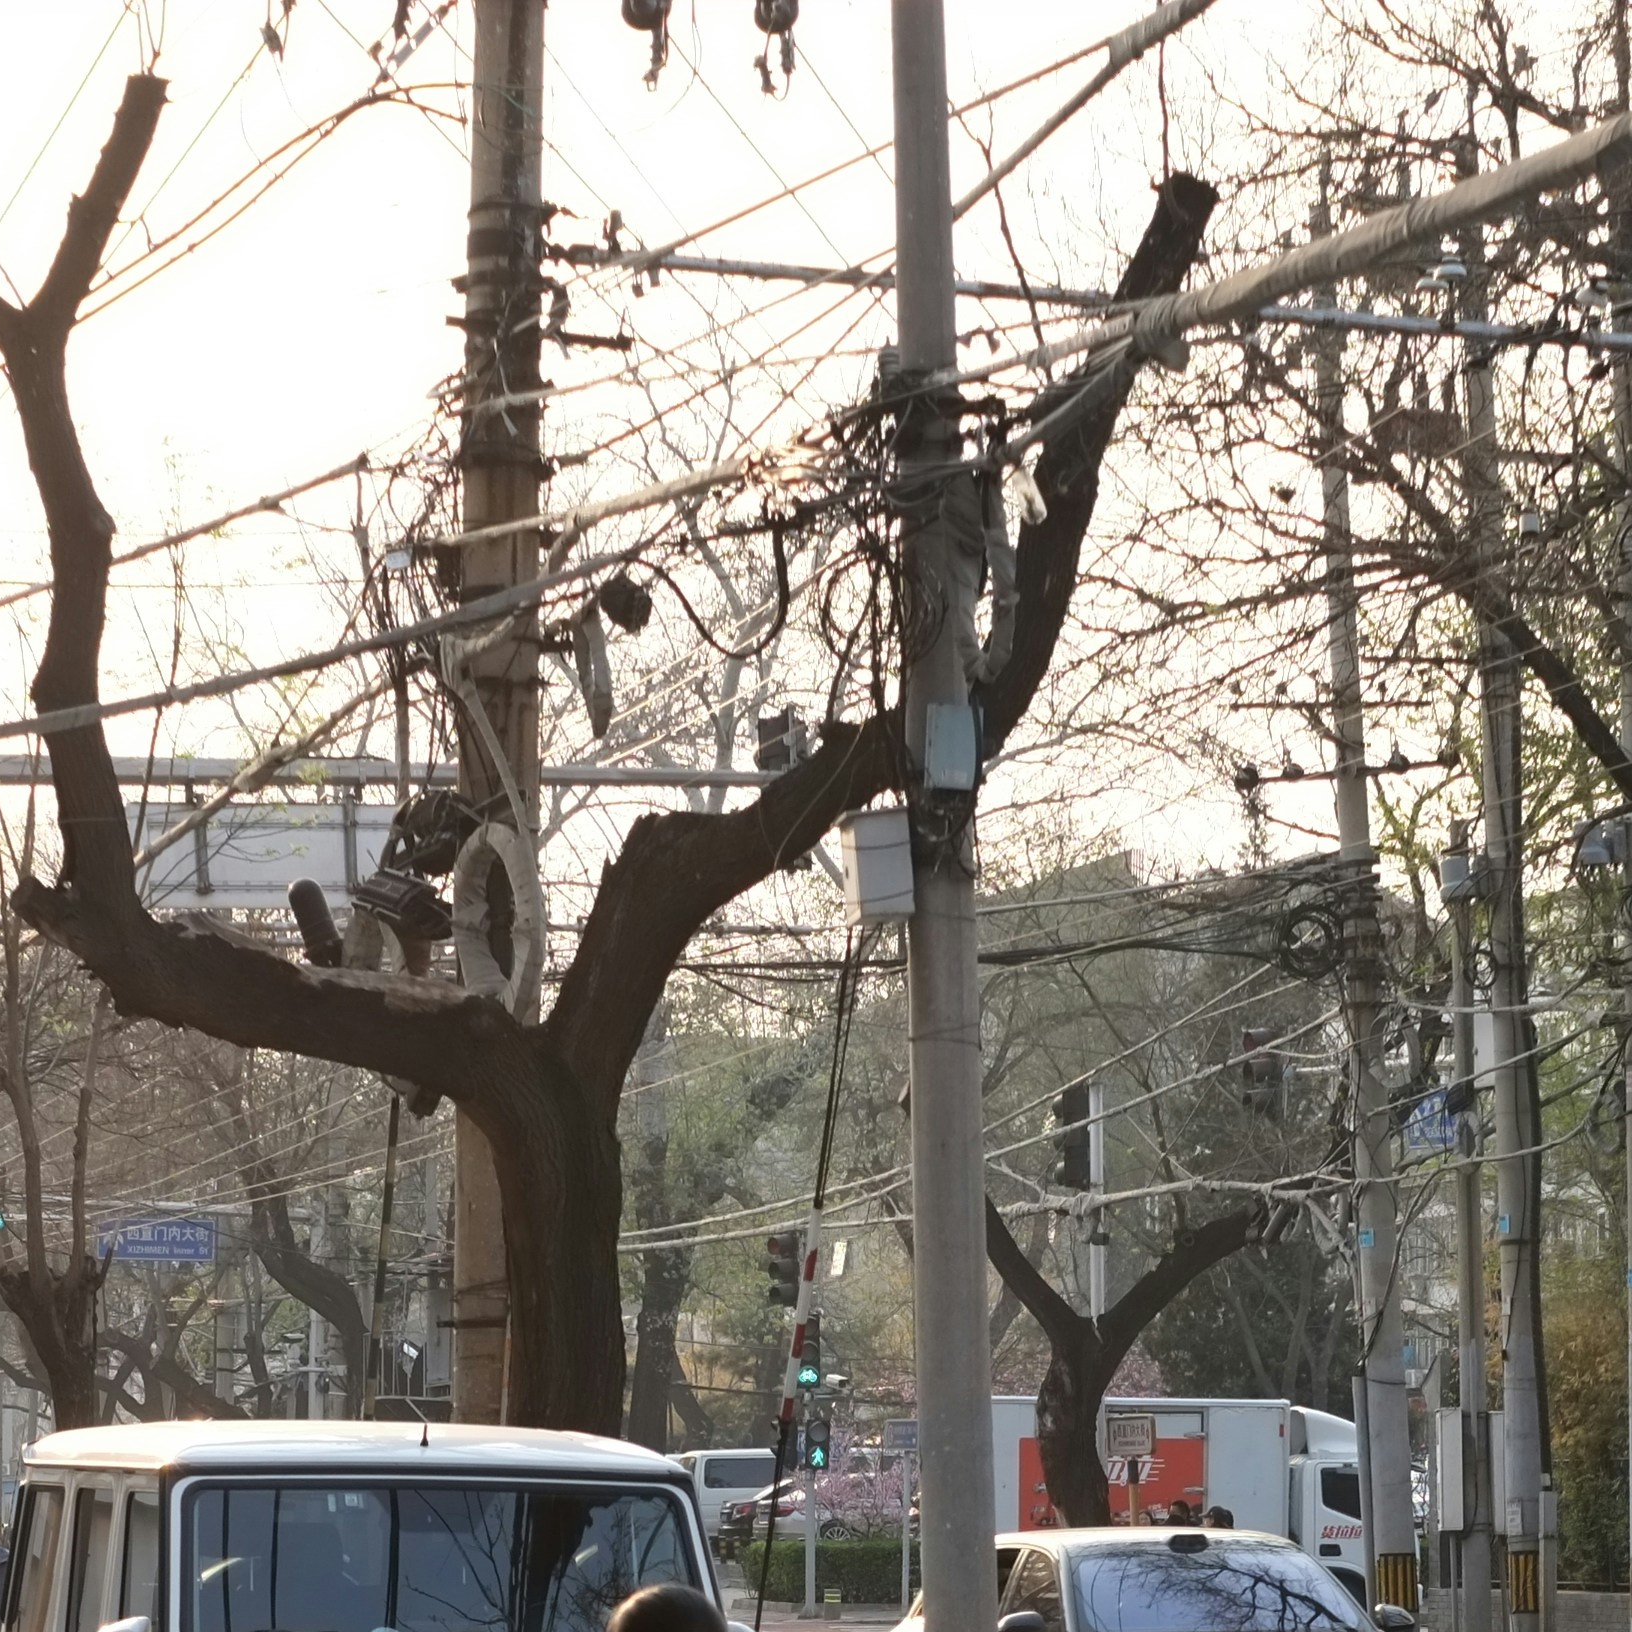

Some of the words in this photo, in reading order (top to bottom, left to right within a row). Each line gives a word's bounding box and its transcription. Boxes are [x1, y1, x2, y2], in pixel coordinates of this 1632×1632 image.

[127, 1225, 209, 1241] 西直门内大街
[127, 1245, 169, 1255] XIZHIMEN
